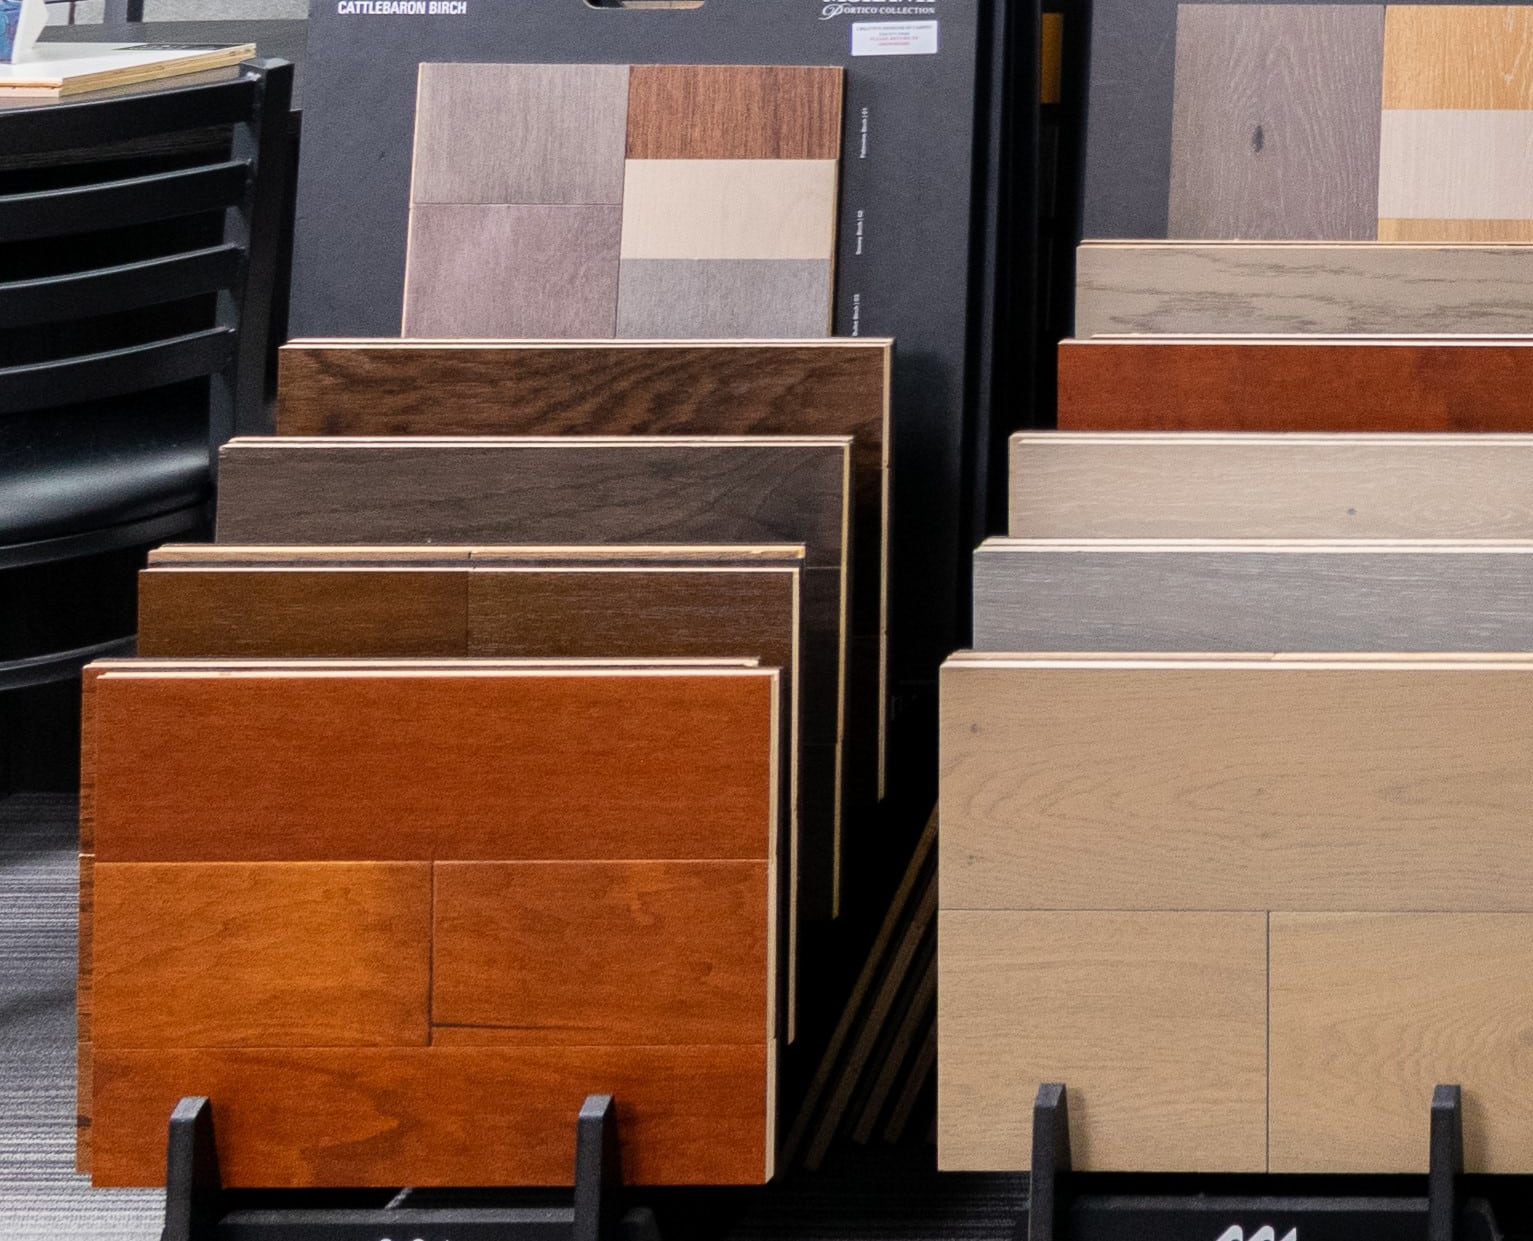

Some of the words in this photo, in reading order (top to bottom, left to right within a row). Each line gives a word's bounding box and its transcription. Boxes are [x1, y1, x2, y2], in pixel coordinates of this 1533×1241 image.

[337, 1, 426, 15] CATTLEBARON
[428, 1, 467, 15] BIRCH
[818, 4, 877, 20] PORTICO
[878, 5, 936, 15] COLLECTION
